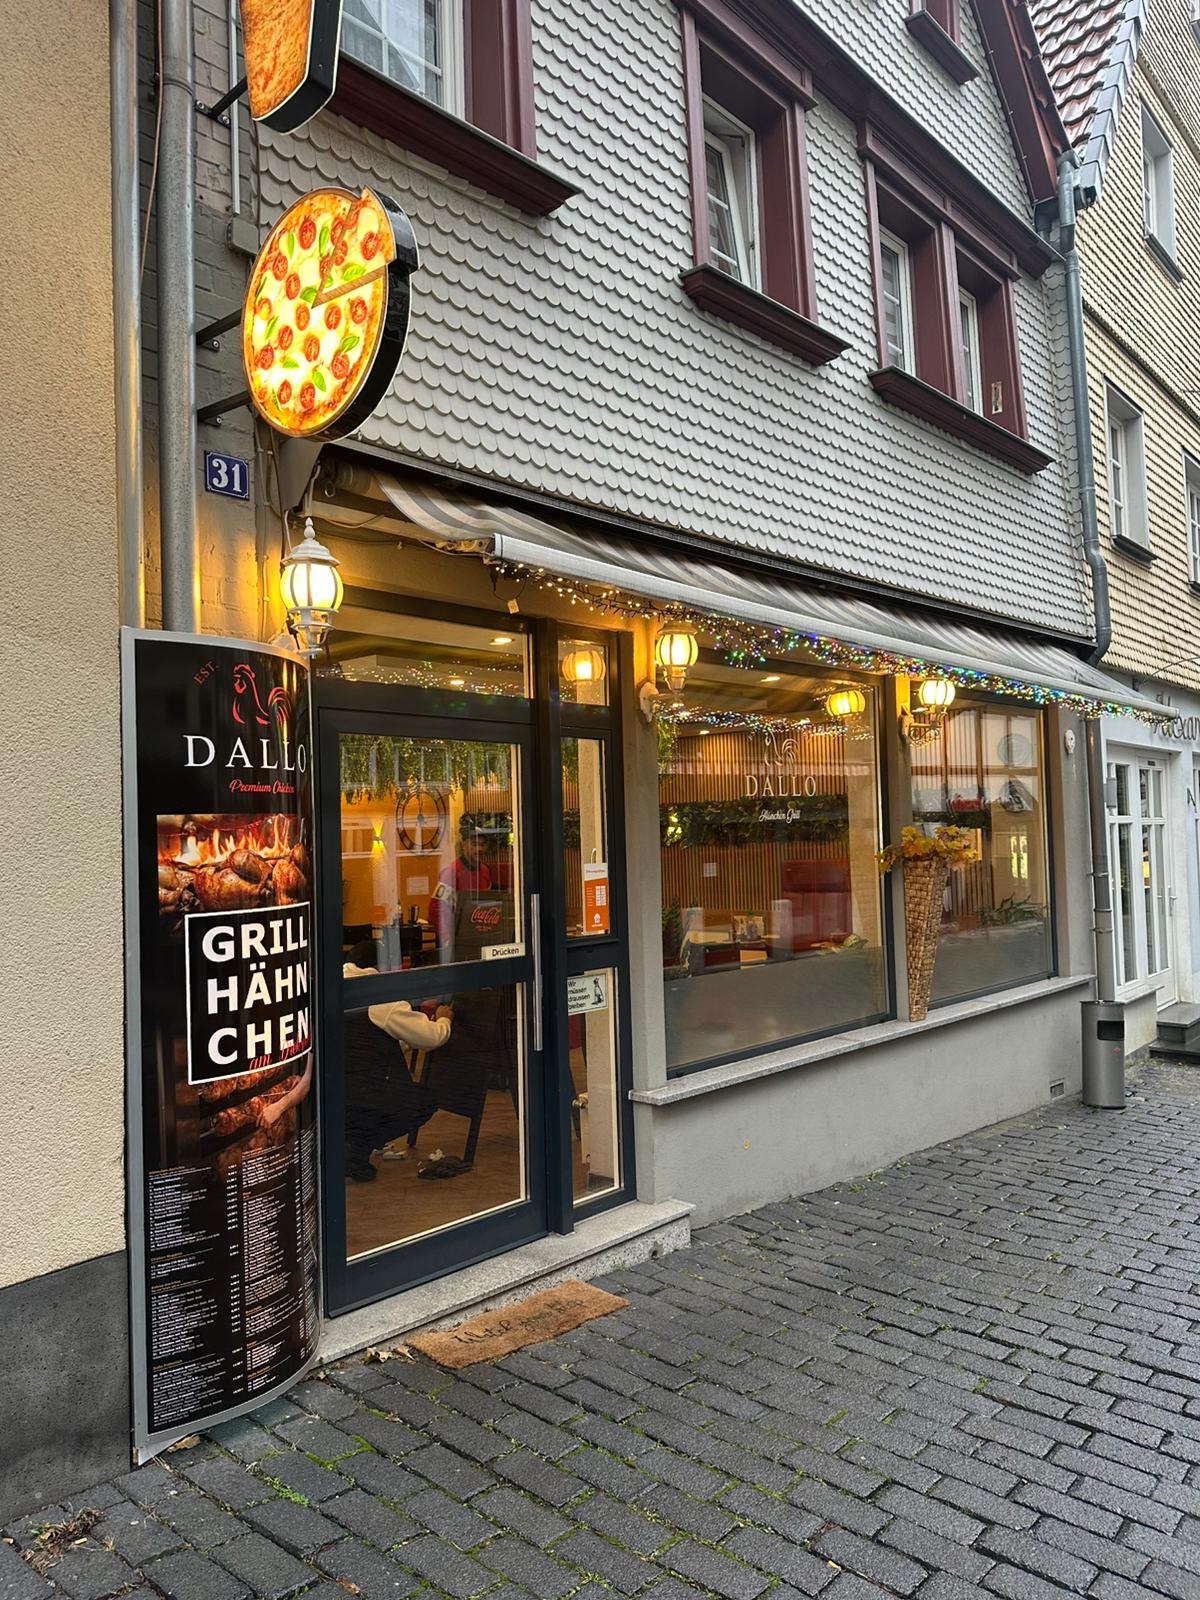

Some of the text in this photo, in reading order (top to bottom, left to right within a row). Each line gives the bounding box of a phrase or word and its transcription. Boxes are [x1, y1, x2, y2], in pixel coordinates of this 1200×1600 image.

[212, 458, 242, 492] 31
[183, 734, 307, 773] DALLO
[229, 778, 272, 793] Premium
[745, 775, 817, 797] DALLO
[202, 916, 308, 963] GRILL
[491, 946, 520, 957] Drücken
[207, 961, 308, 1015] HÄHN
[208, 1007, 308, 1065] CHEN
